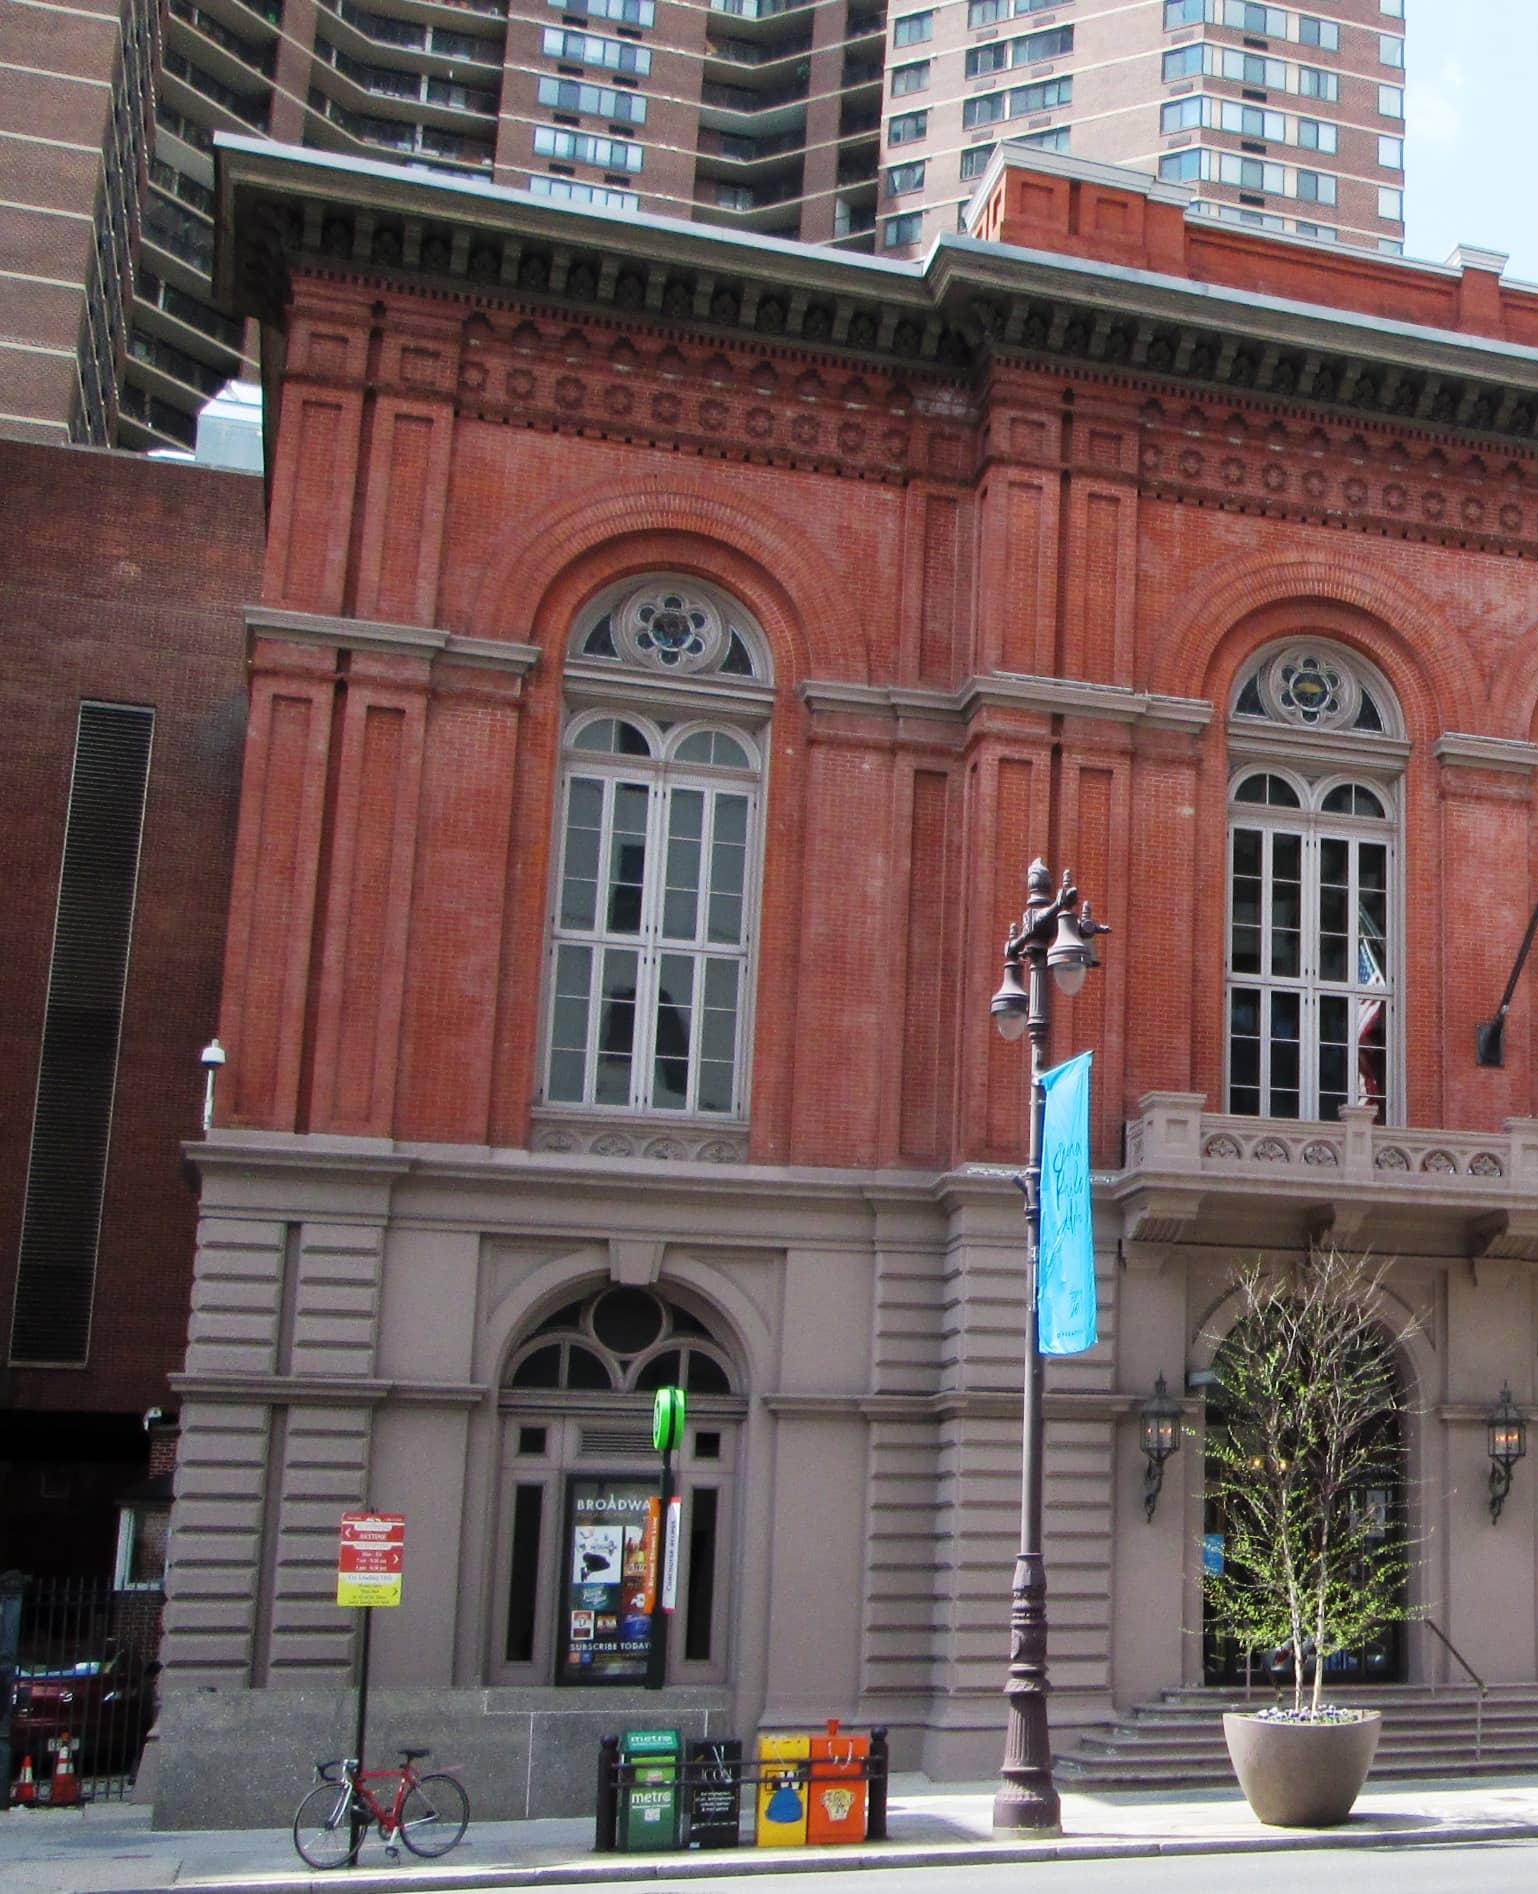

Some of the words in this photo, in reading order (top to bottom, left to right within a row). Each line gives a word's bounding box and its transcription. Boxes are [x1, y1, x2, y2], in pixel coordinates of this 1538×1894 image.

[576, 1493, 652, 1511] BROADWA
[570, 1642, 617, 1651] SUBSCRIBE
[631, 1791, 671, 1804] metro
